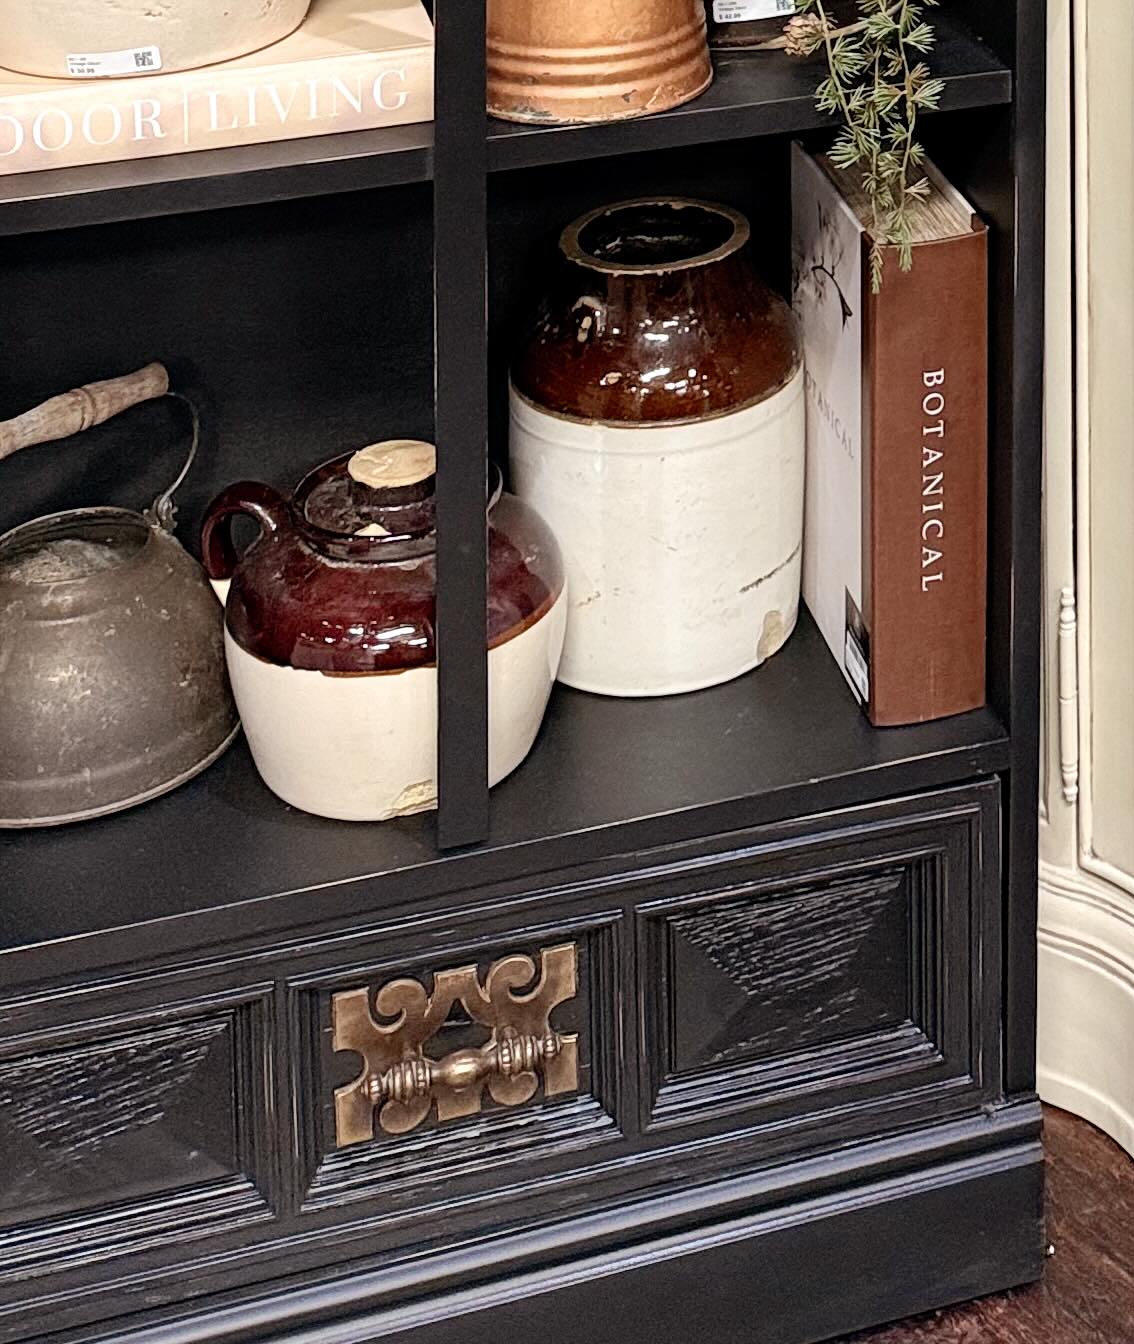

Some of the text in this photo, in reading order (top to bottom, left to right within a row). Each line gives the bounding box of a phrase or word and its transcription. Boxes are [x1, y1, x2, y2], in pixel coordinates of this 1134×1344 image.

[207, 68, 409, 132] LIVING
[805, 370, 854, 459] OTANICAL
[921, 367, 945, 593] BOTANICAL
